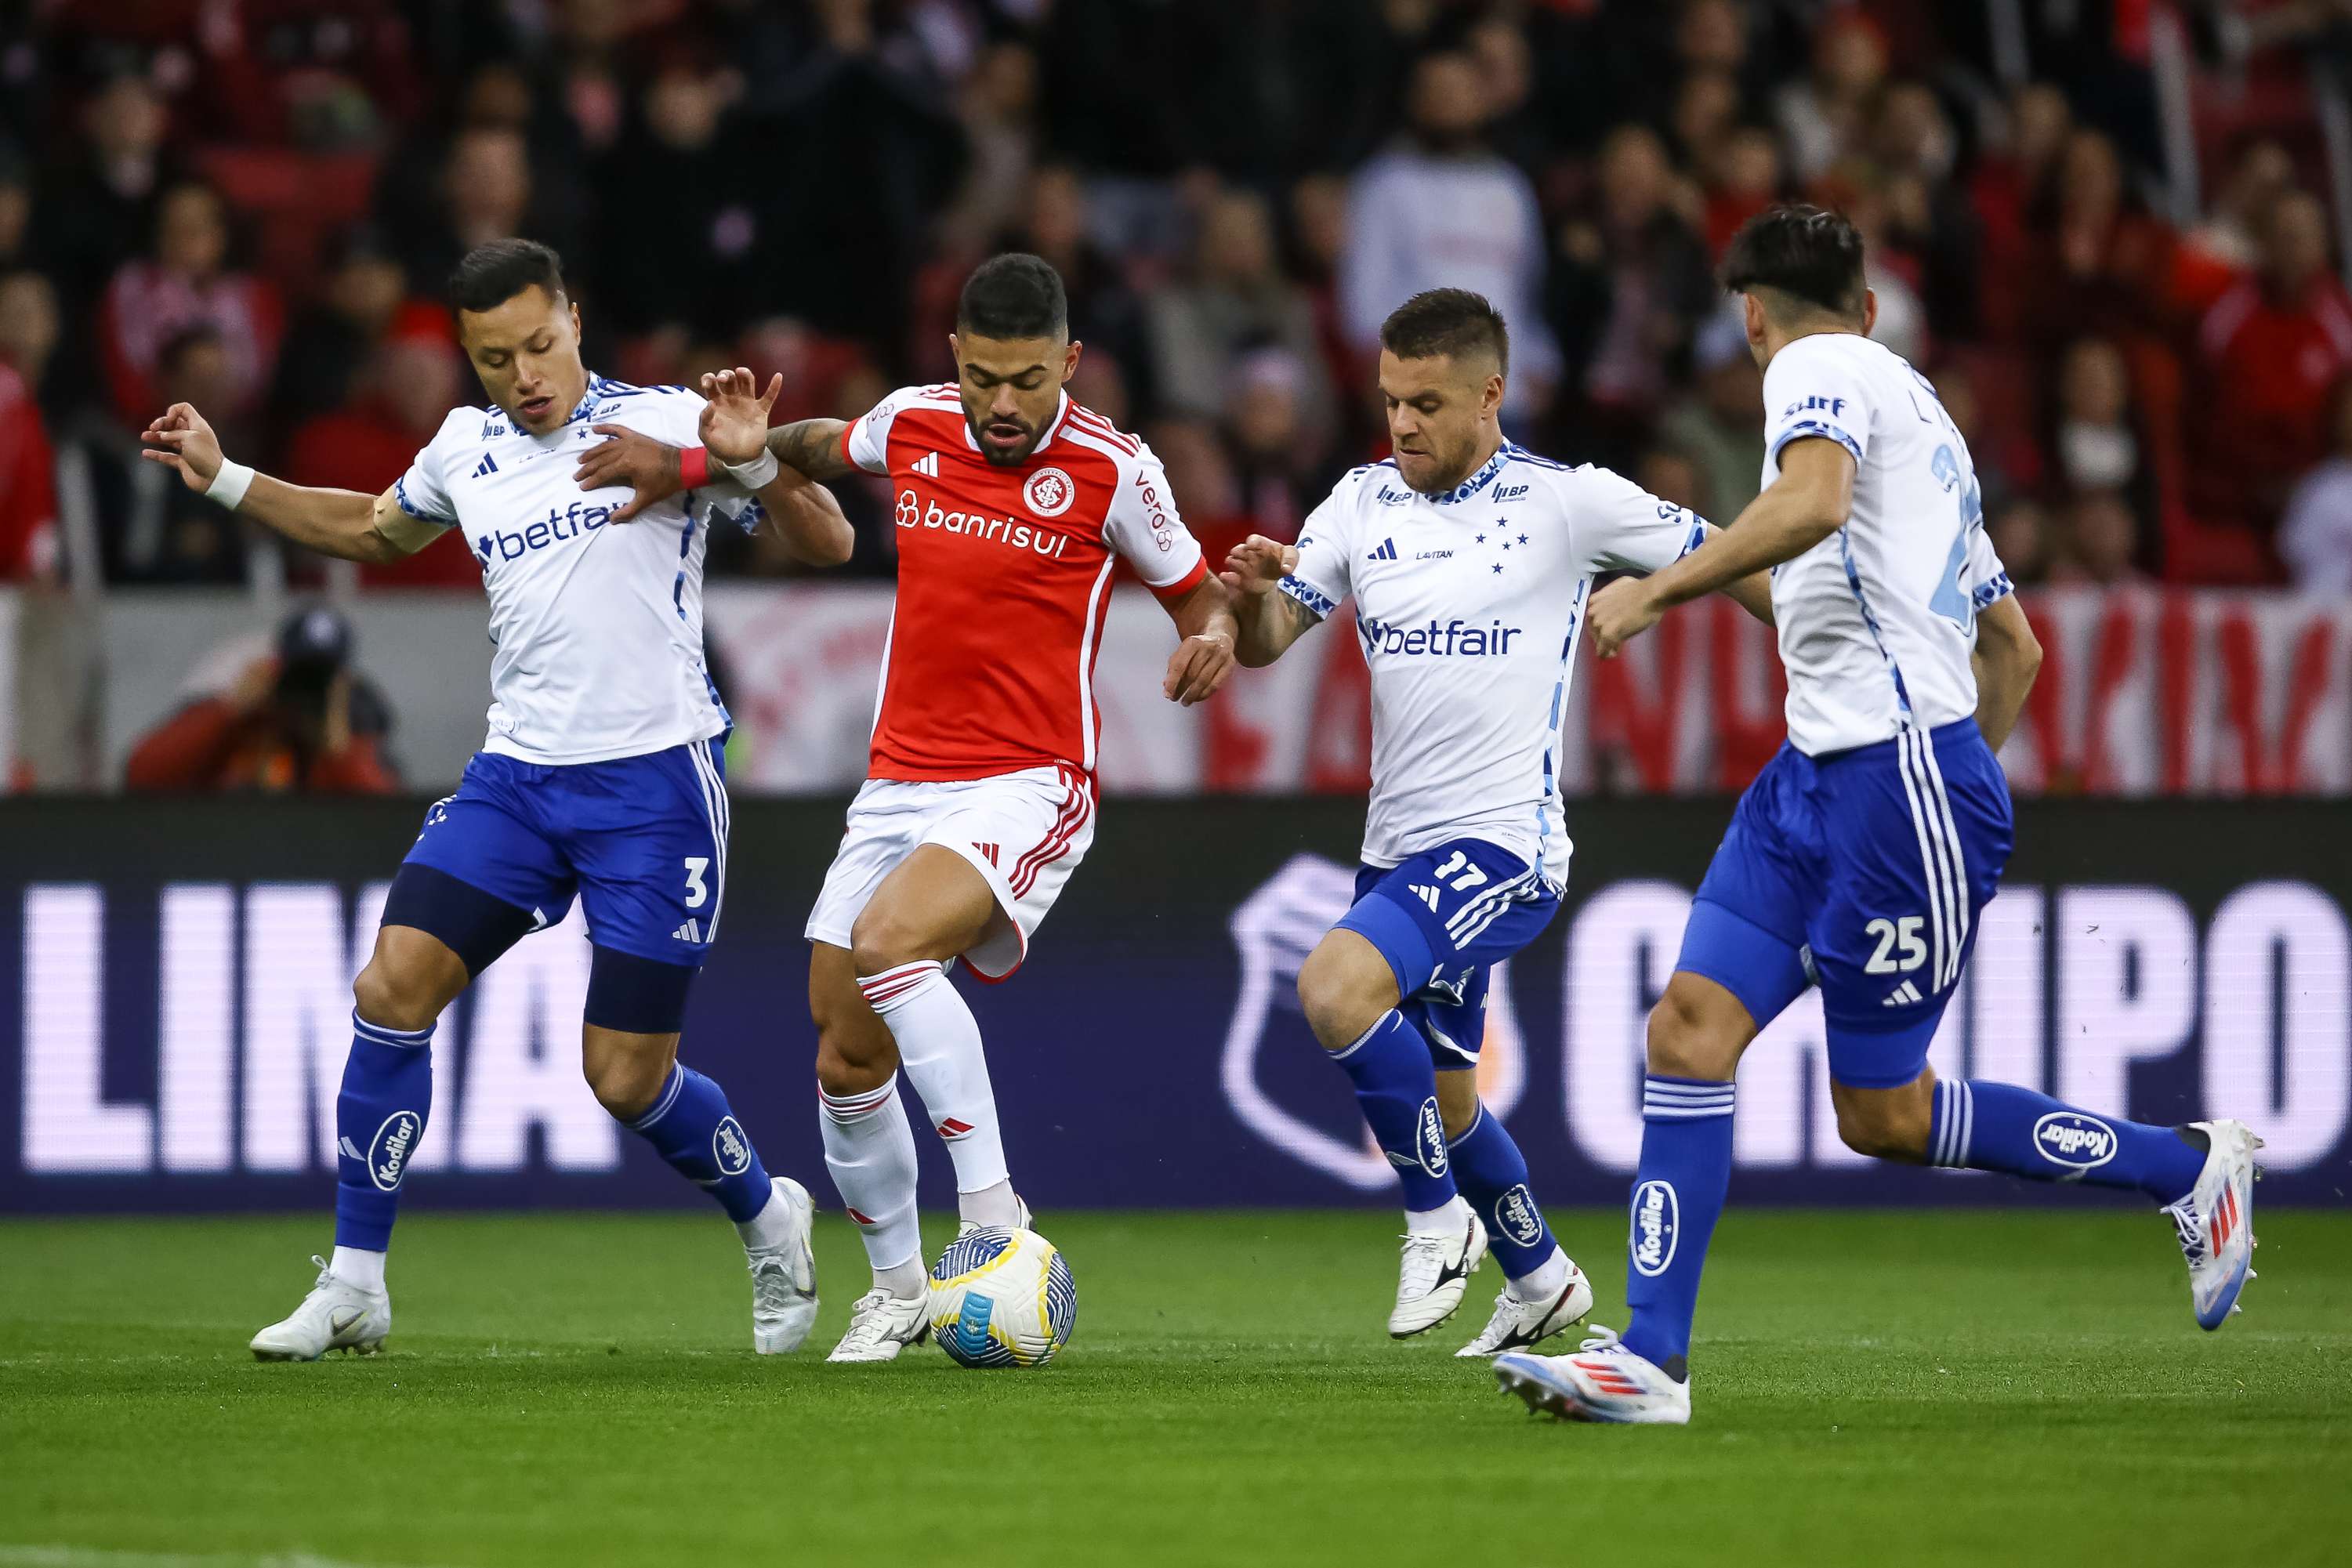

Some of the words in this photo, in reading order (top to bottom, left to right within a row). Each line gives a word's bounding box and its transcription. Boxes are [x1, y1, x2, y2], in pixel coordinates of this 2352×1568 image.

[1508, 484, 1529, 497] BP
[495, 501, 628, 563] betfa
[923, 499, 1068, 559] banrisul
[1415, 550, 1454, 559] LAVITAN
[1383, 620, 1522, 657] betfair
[684, 856, 708, 908] 3
[1433, 850, 1488, 892] 17
[1865, 916, 1927, 972] 25
[22, 881, 622, 1172] LIMA
[379, 1117, 414, 1182] Kodilar
[1424, 1107, 1445, 1169] Kodilar
[2040, 1123, 2110, 1157] Kodilar
[1638, 1184, 1665, 1266] Kodilar
